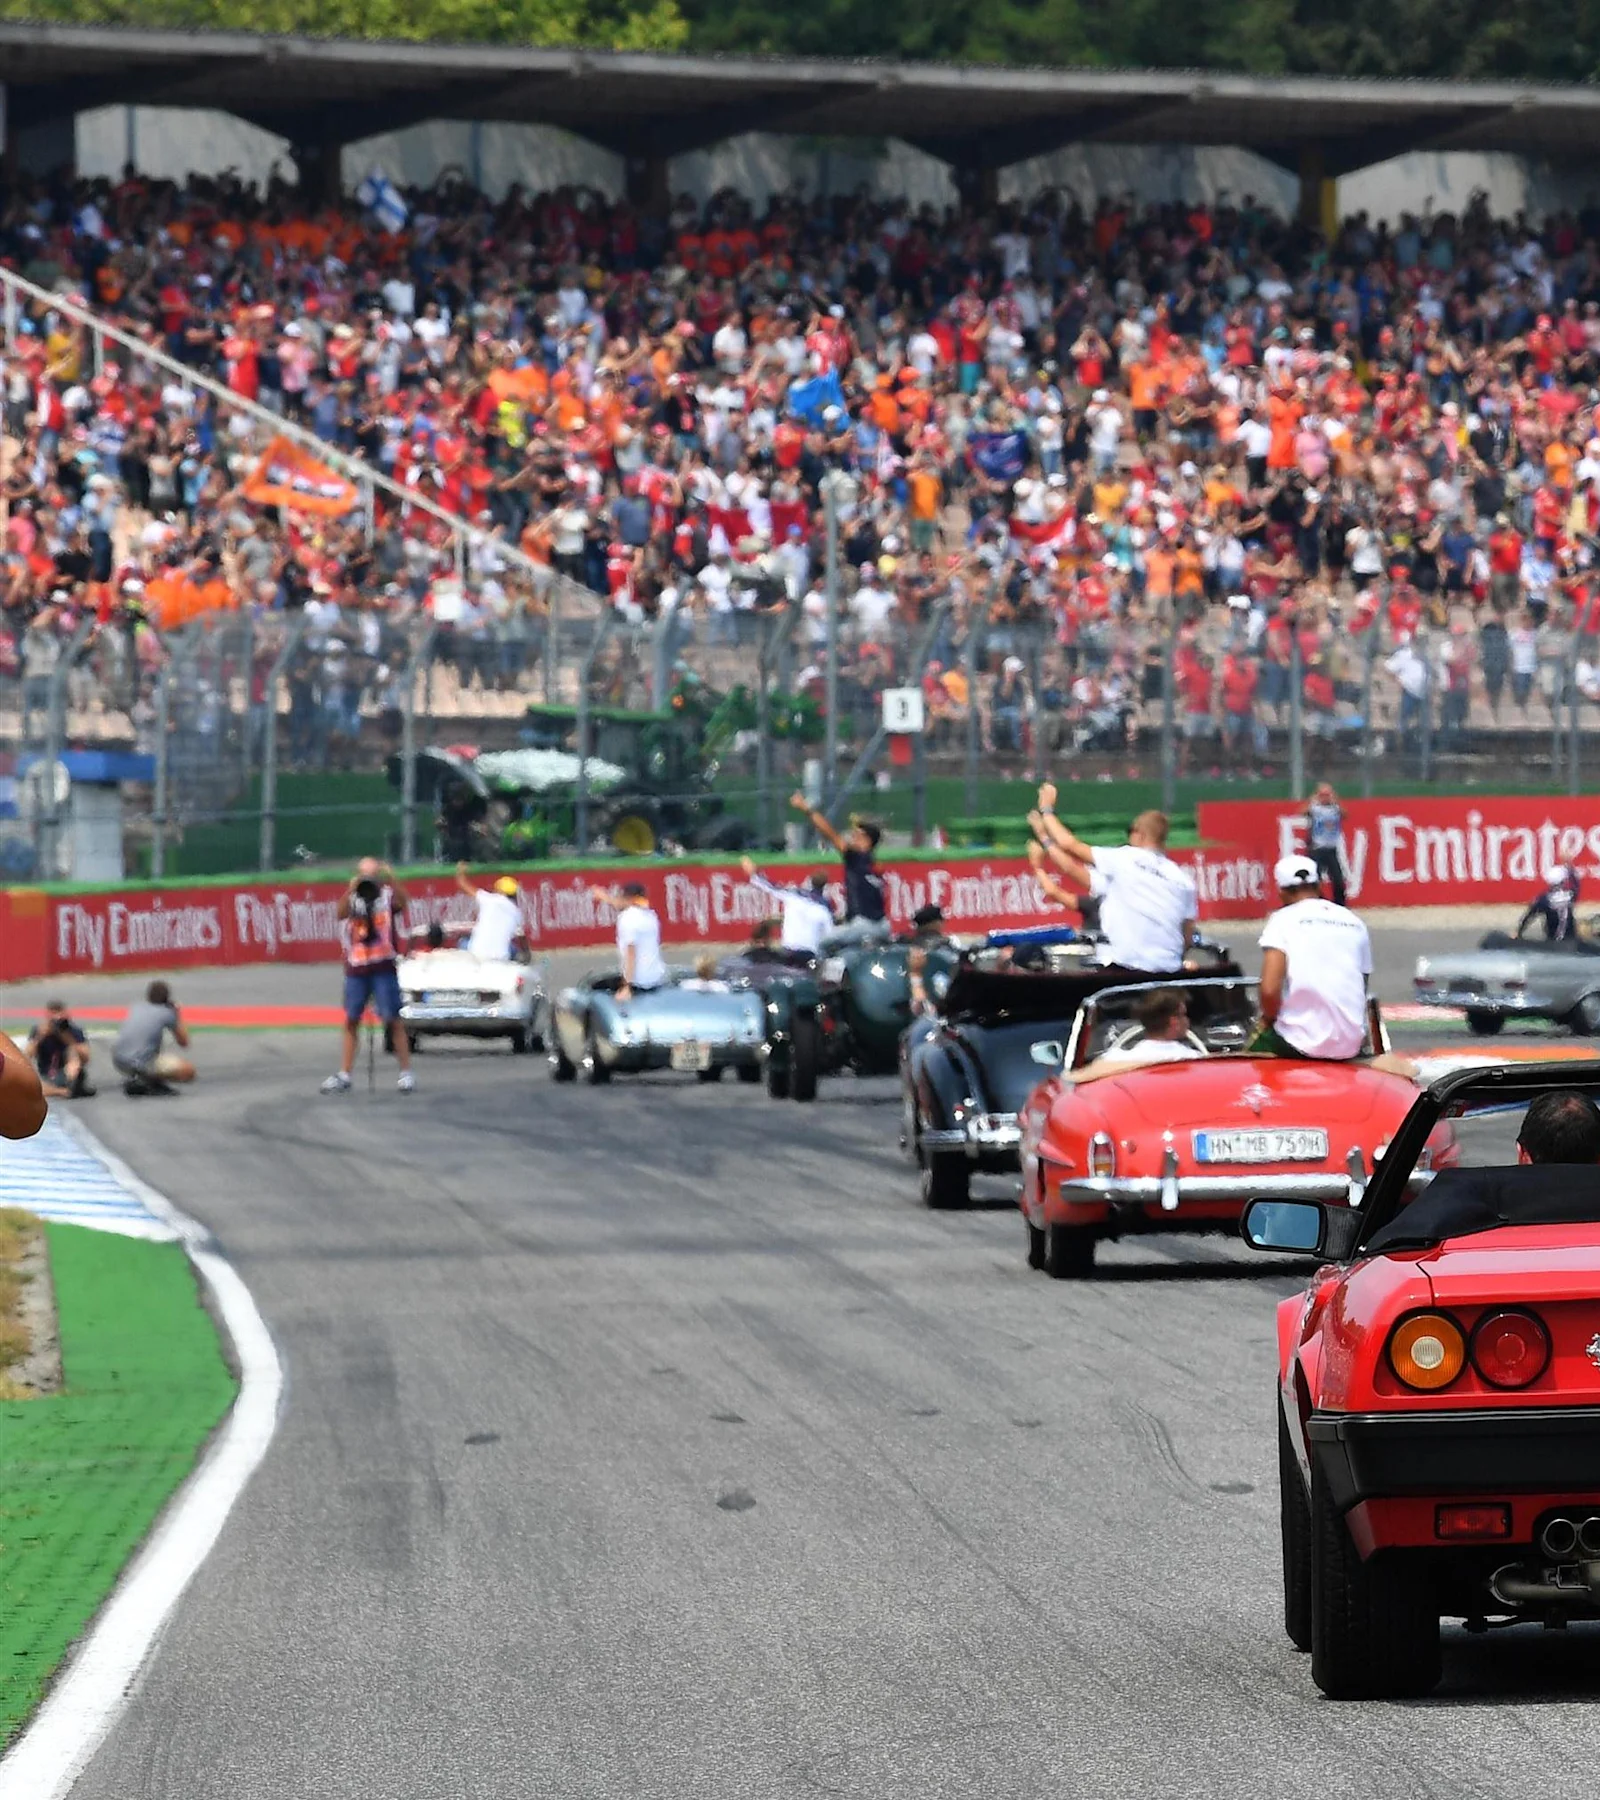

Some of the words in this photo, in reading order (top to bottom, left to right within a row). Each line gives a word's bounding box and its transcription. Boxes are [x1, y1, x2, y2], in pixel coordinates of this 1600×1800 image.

[56, 903, 105, 967] Fly
[108, 896, 222, 956] Emirates
[1211, 1138, 1232, 1155] HN
